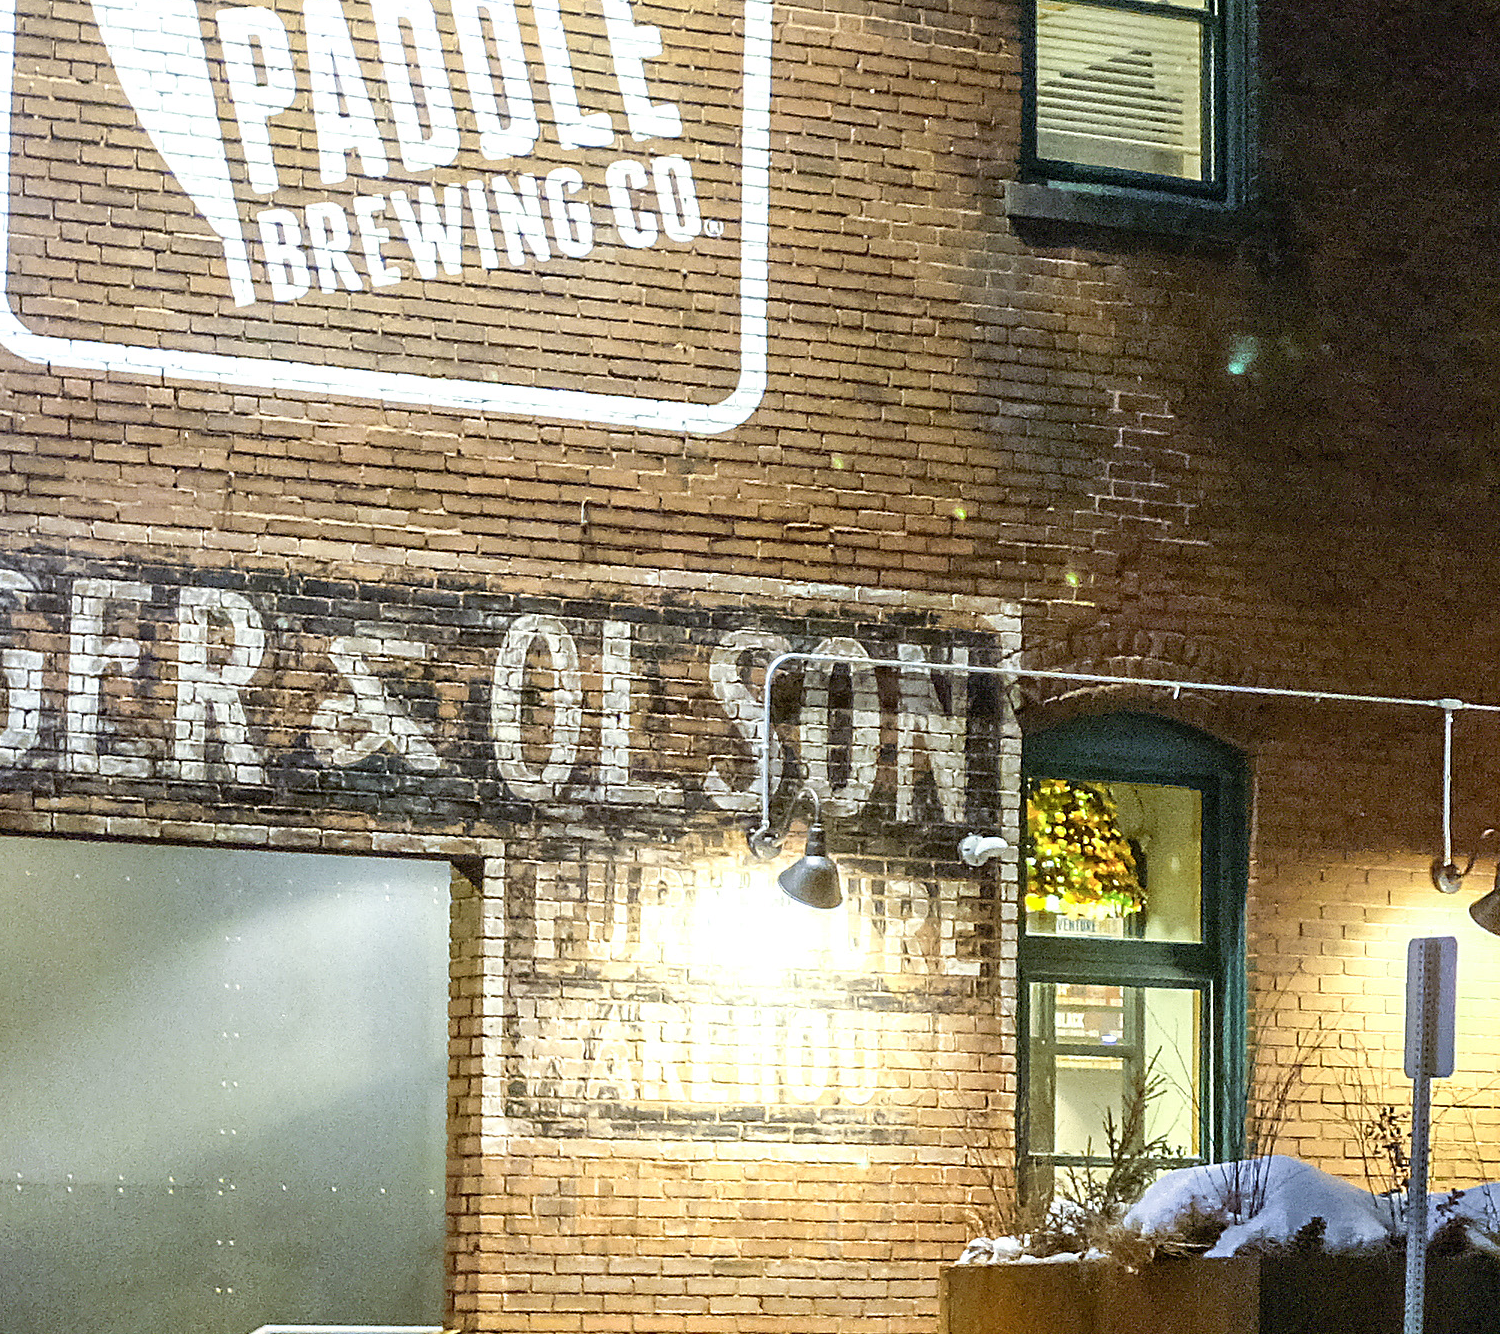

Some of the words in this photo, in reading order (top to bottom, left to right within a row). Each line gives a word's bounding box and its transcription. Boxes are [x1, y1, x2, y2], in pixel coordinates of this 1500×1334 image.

[258, 165, 594, 305] BREWING
[307, 633, 441, 770] &
[490, 614, 969, 825] OLSON
